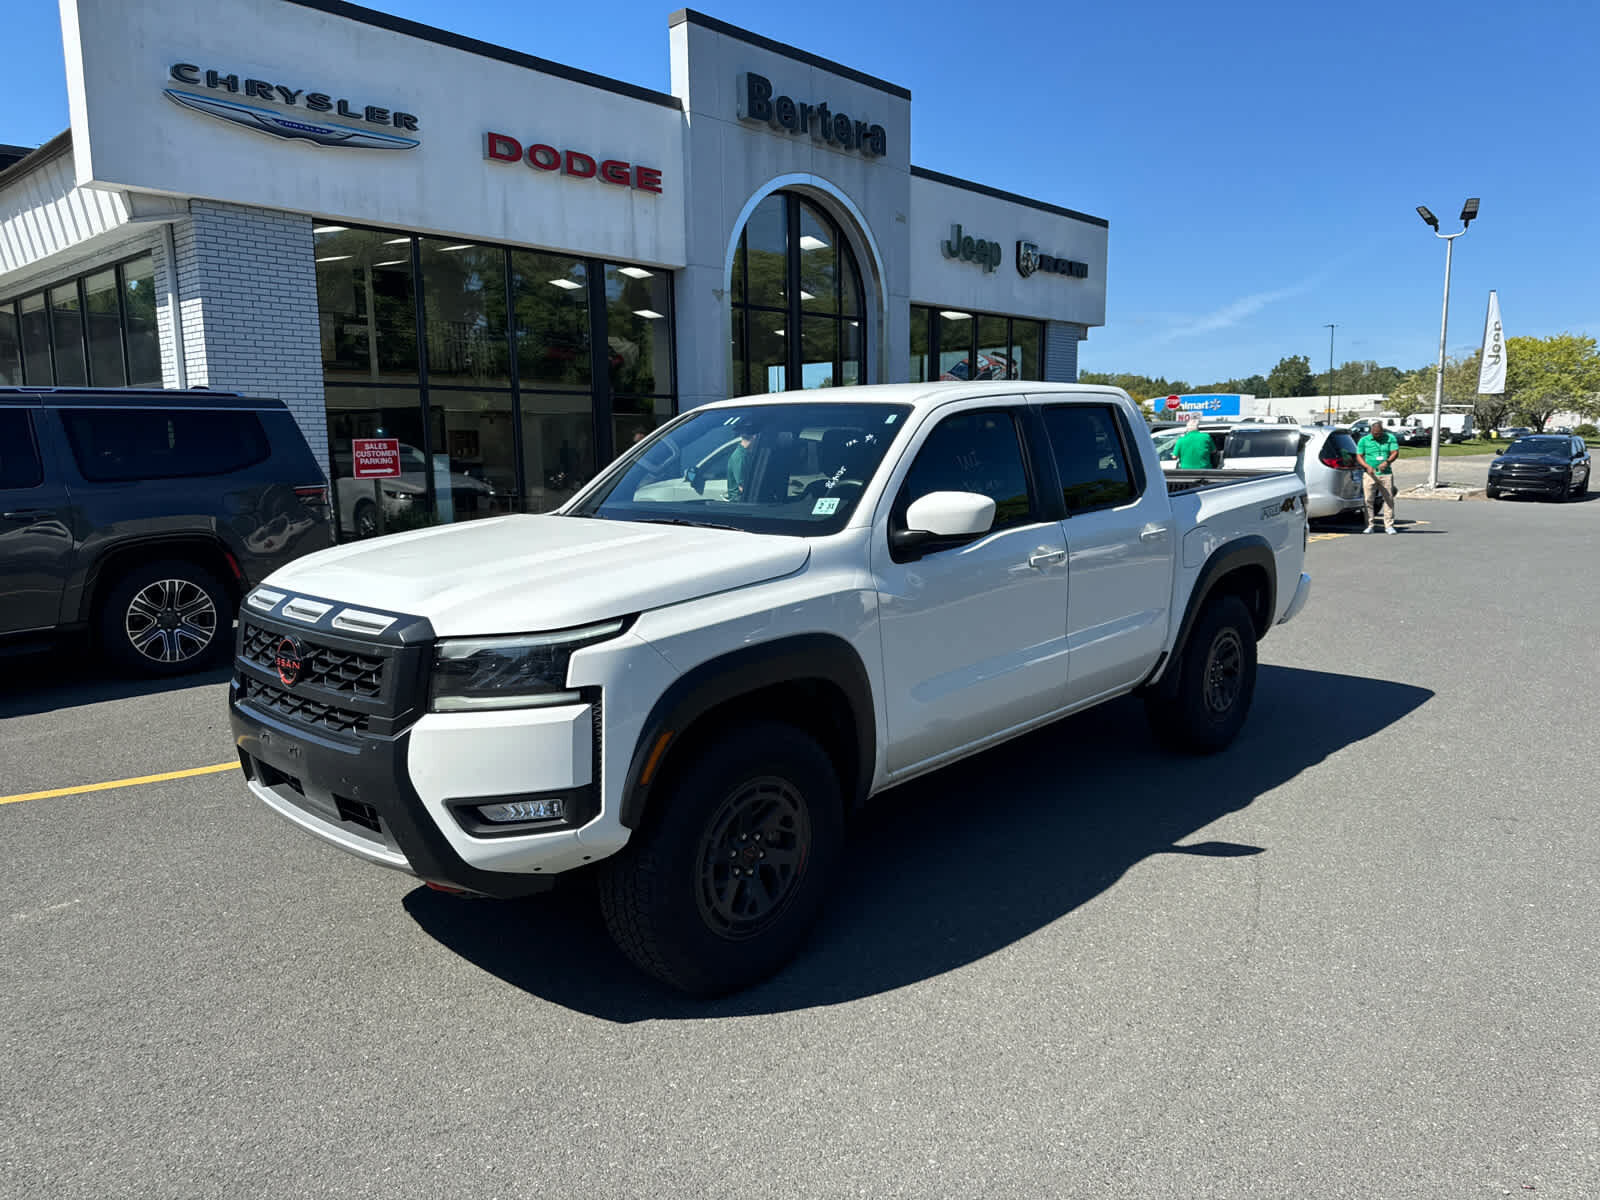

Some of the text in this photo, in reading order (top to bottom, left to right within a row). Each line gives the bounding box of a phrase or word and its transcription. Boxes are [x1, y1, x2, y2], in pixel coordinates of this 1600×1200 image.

[169, 63, 420, 132] CHRYSLER
[744, 71, 887, 157] Bertera
[485, 131, 663, 194] DODGE
[941, 223, 1002, 273] Jeep
[1040, 254, 1089, 279] RAM
[1488, 320, 1502, 365] Jeep
[1180, 401, 1209, 410] almart
[355, 450, 397, 458] CUSTOMER
